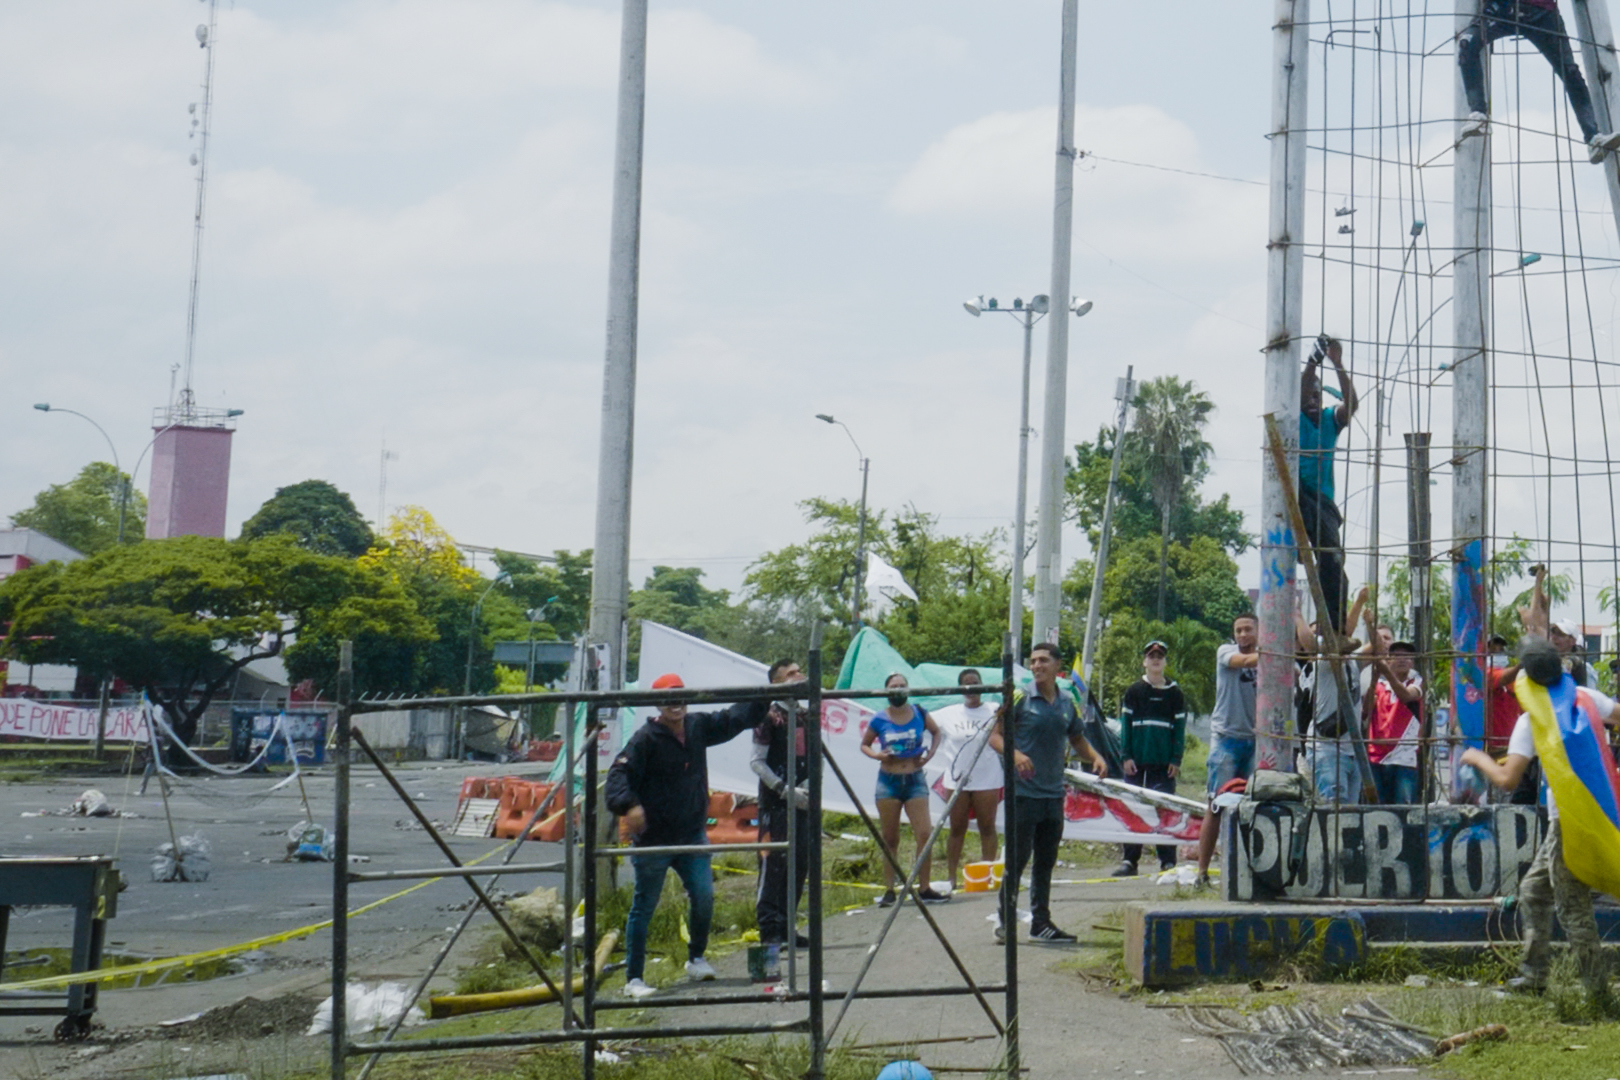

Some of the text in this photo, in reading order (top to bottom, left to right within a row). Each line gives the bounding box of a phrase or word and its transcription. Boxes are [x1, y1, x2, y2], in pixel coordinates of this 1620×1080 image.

[30, 705, 75, 736] PONE
[79, 711, 95, 737] LA
[954, 720, 986, 733] NIK
[1237, 808, 1497, 900] PUERTO
